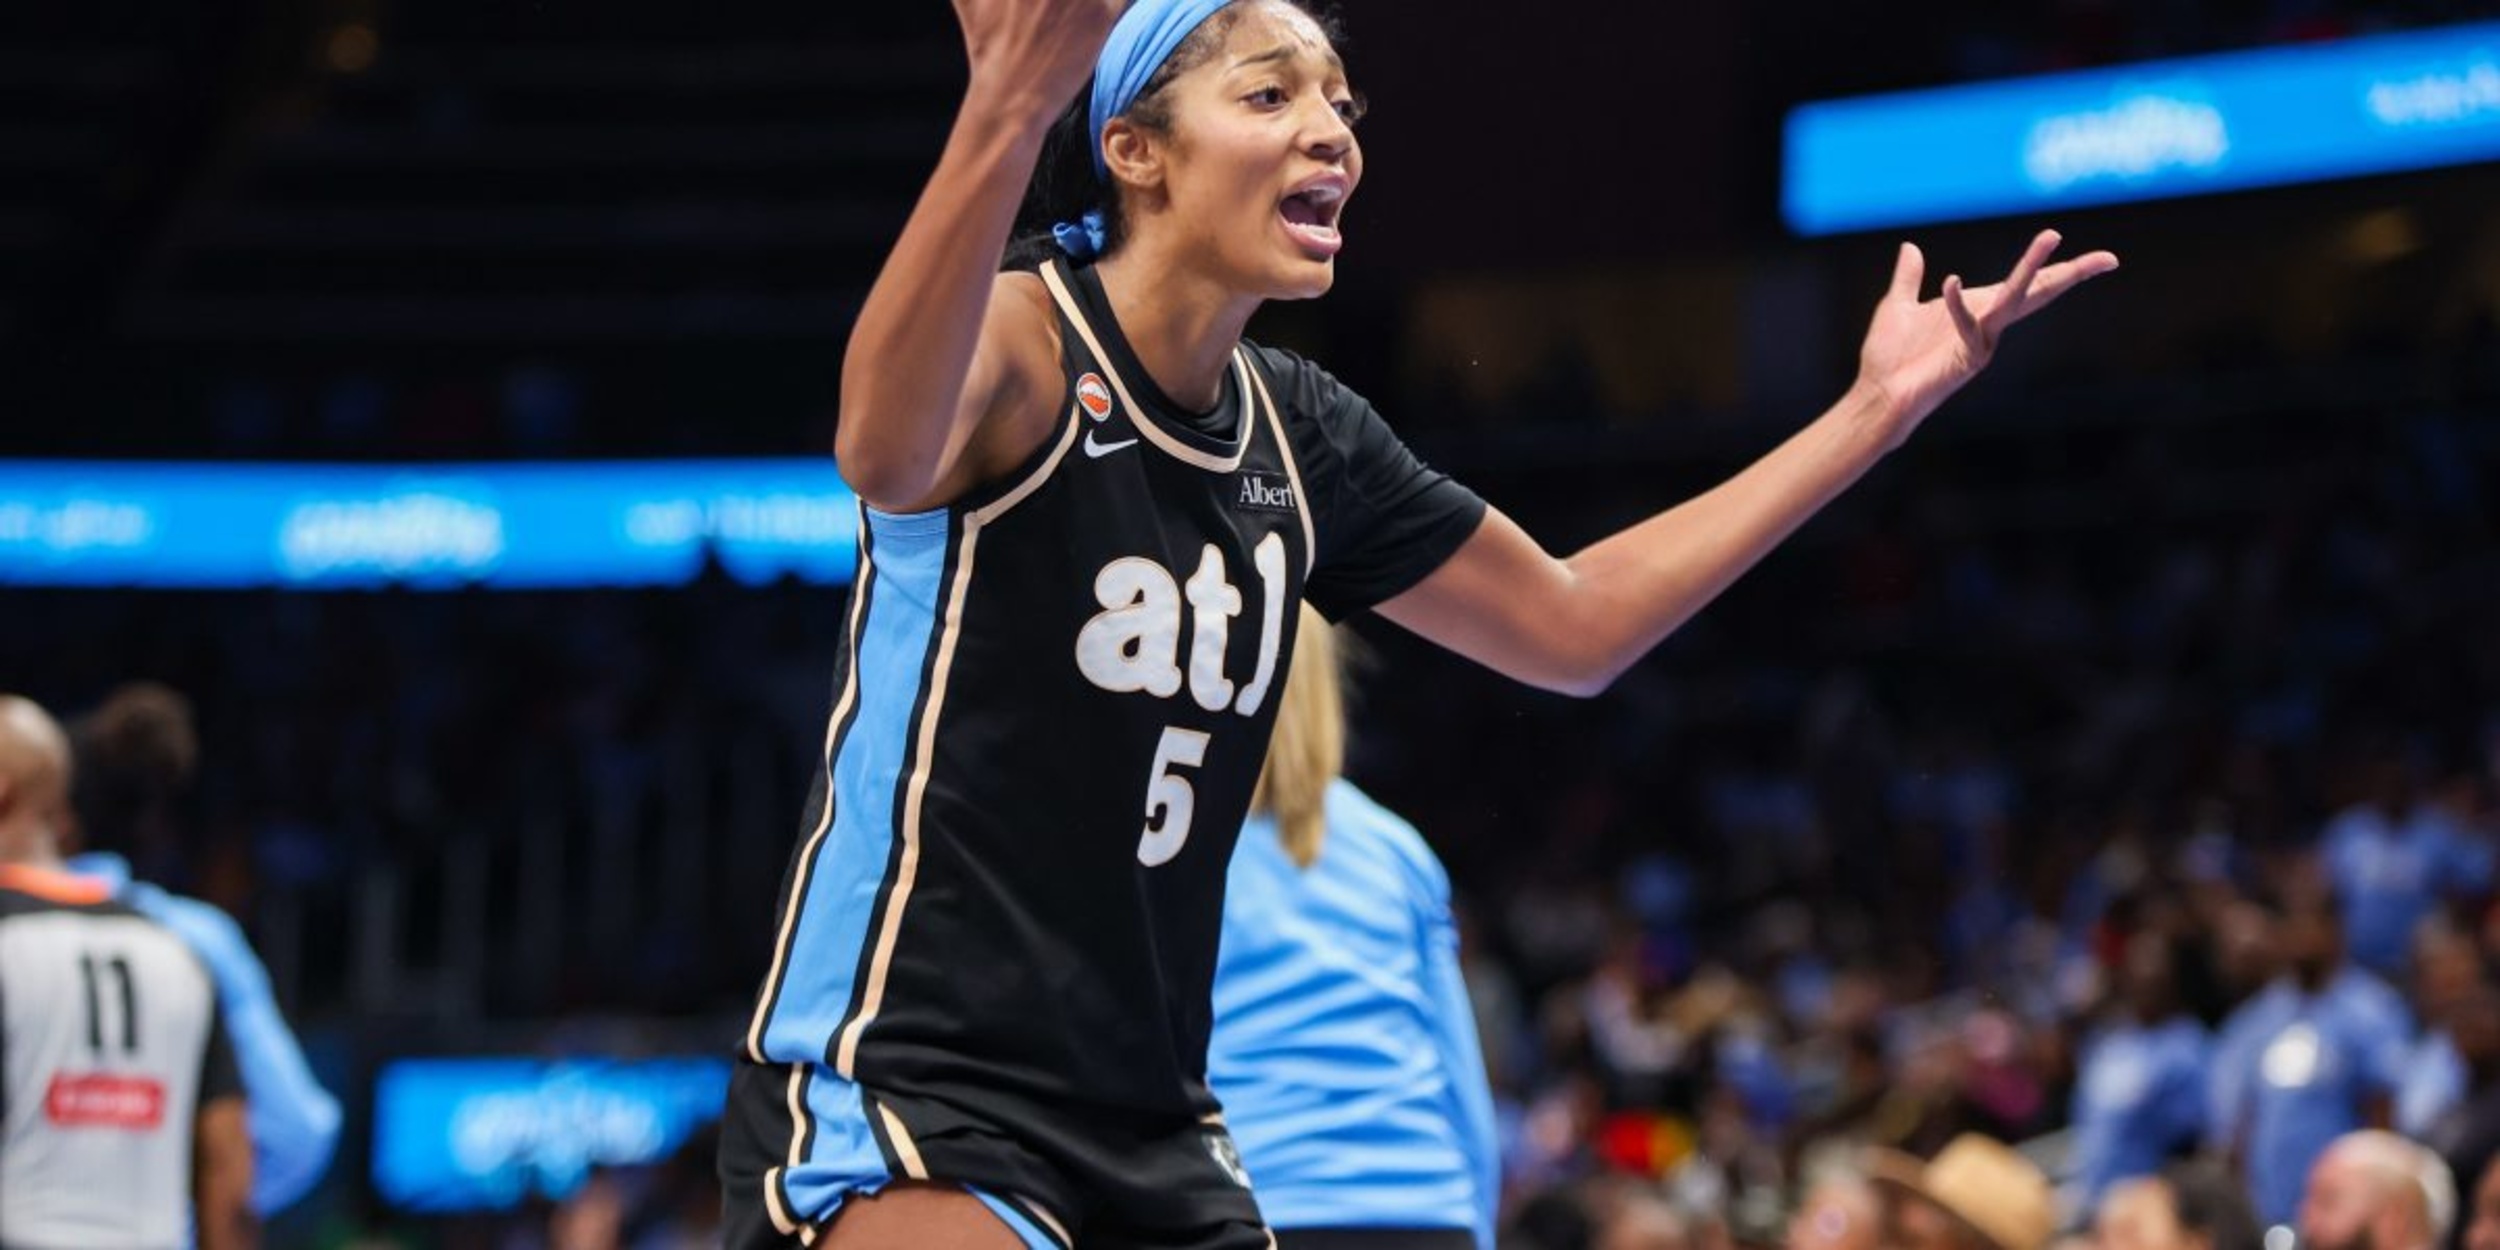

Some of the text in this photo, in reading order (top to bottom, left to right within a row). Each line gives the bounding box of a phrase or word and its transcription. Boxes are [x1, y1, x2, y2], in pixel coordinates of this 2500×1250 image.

[1239, 475, 1295, 507] Albert
[1075, 531, 1286, 717] atl
[1137, 726, 1211, 867] 5
[81, 953, 136, 1052] 11
